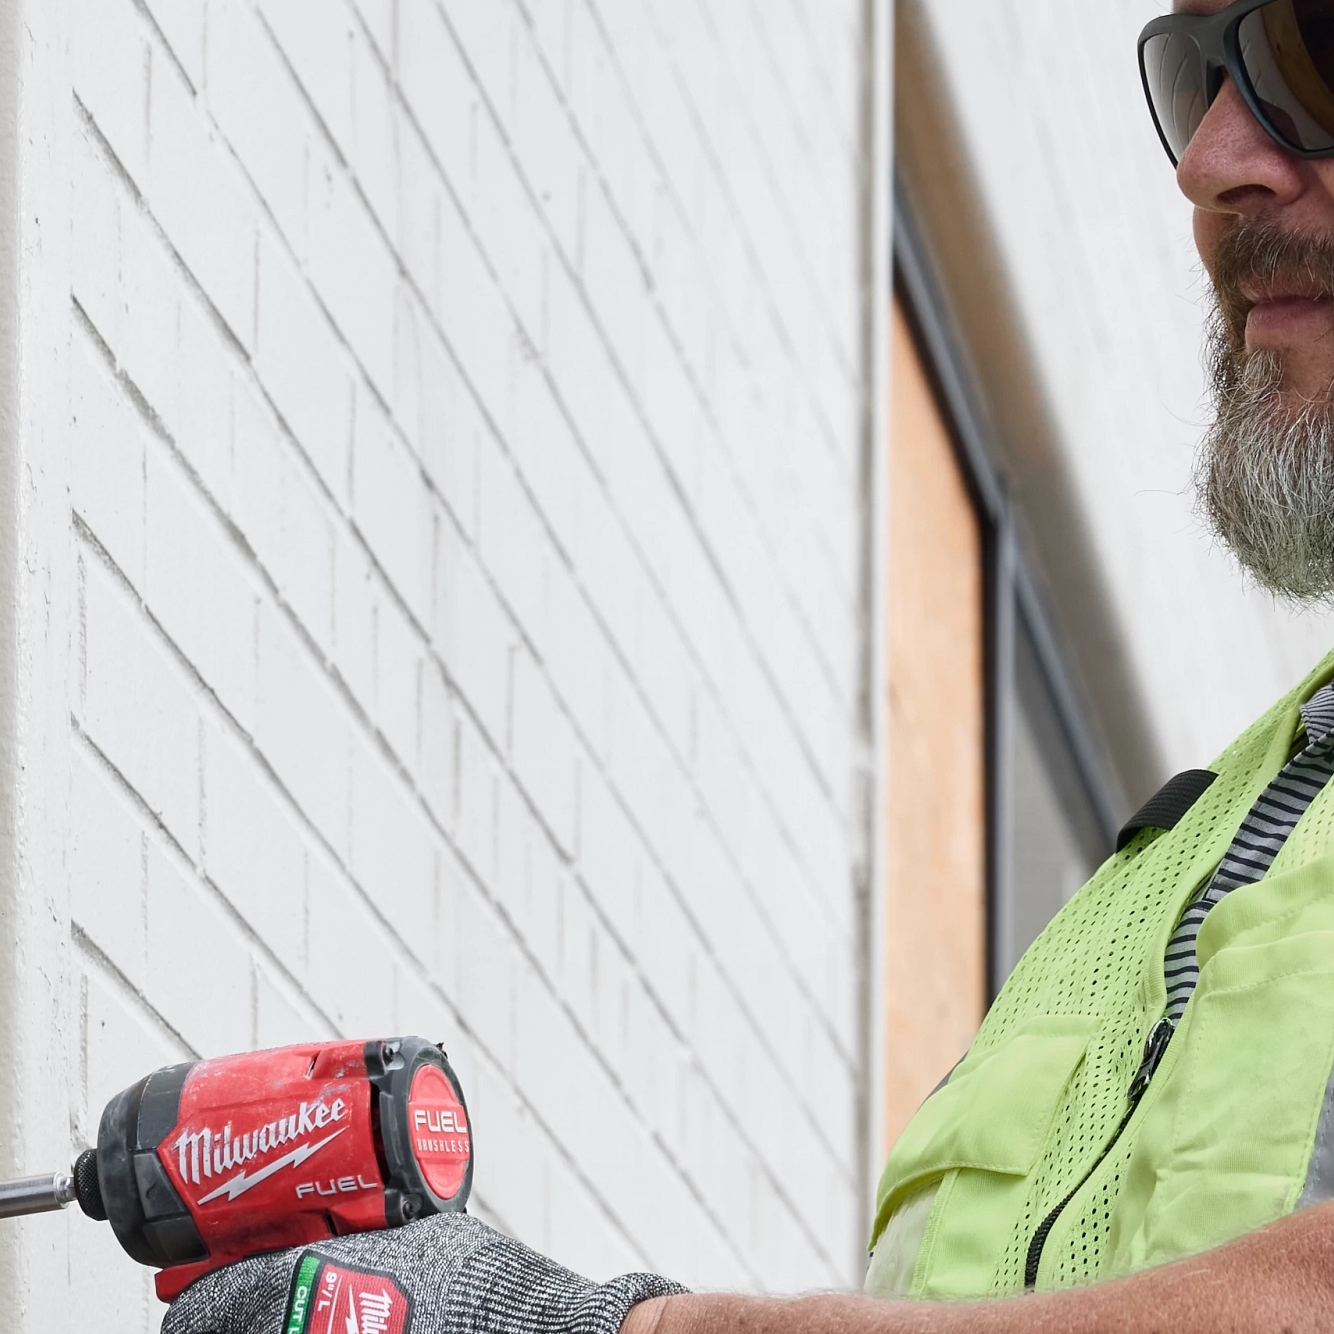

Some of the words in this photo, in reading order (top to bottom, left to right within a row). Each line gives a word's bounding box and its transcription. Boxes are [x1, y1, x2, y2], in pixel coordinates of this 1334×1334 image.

[414, 1110, 467, 1133] FUEL
[171, 1097, 348, 1185] Milwaukee
[417, 1138, 469, 1153] BRUSHLESS
[295, 1174, 378, 1199] FUEL
[293, 1286, 307, 1322] CUT
